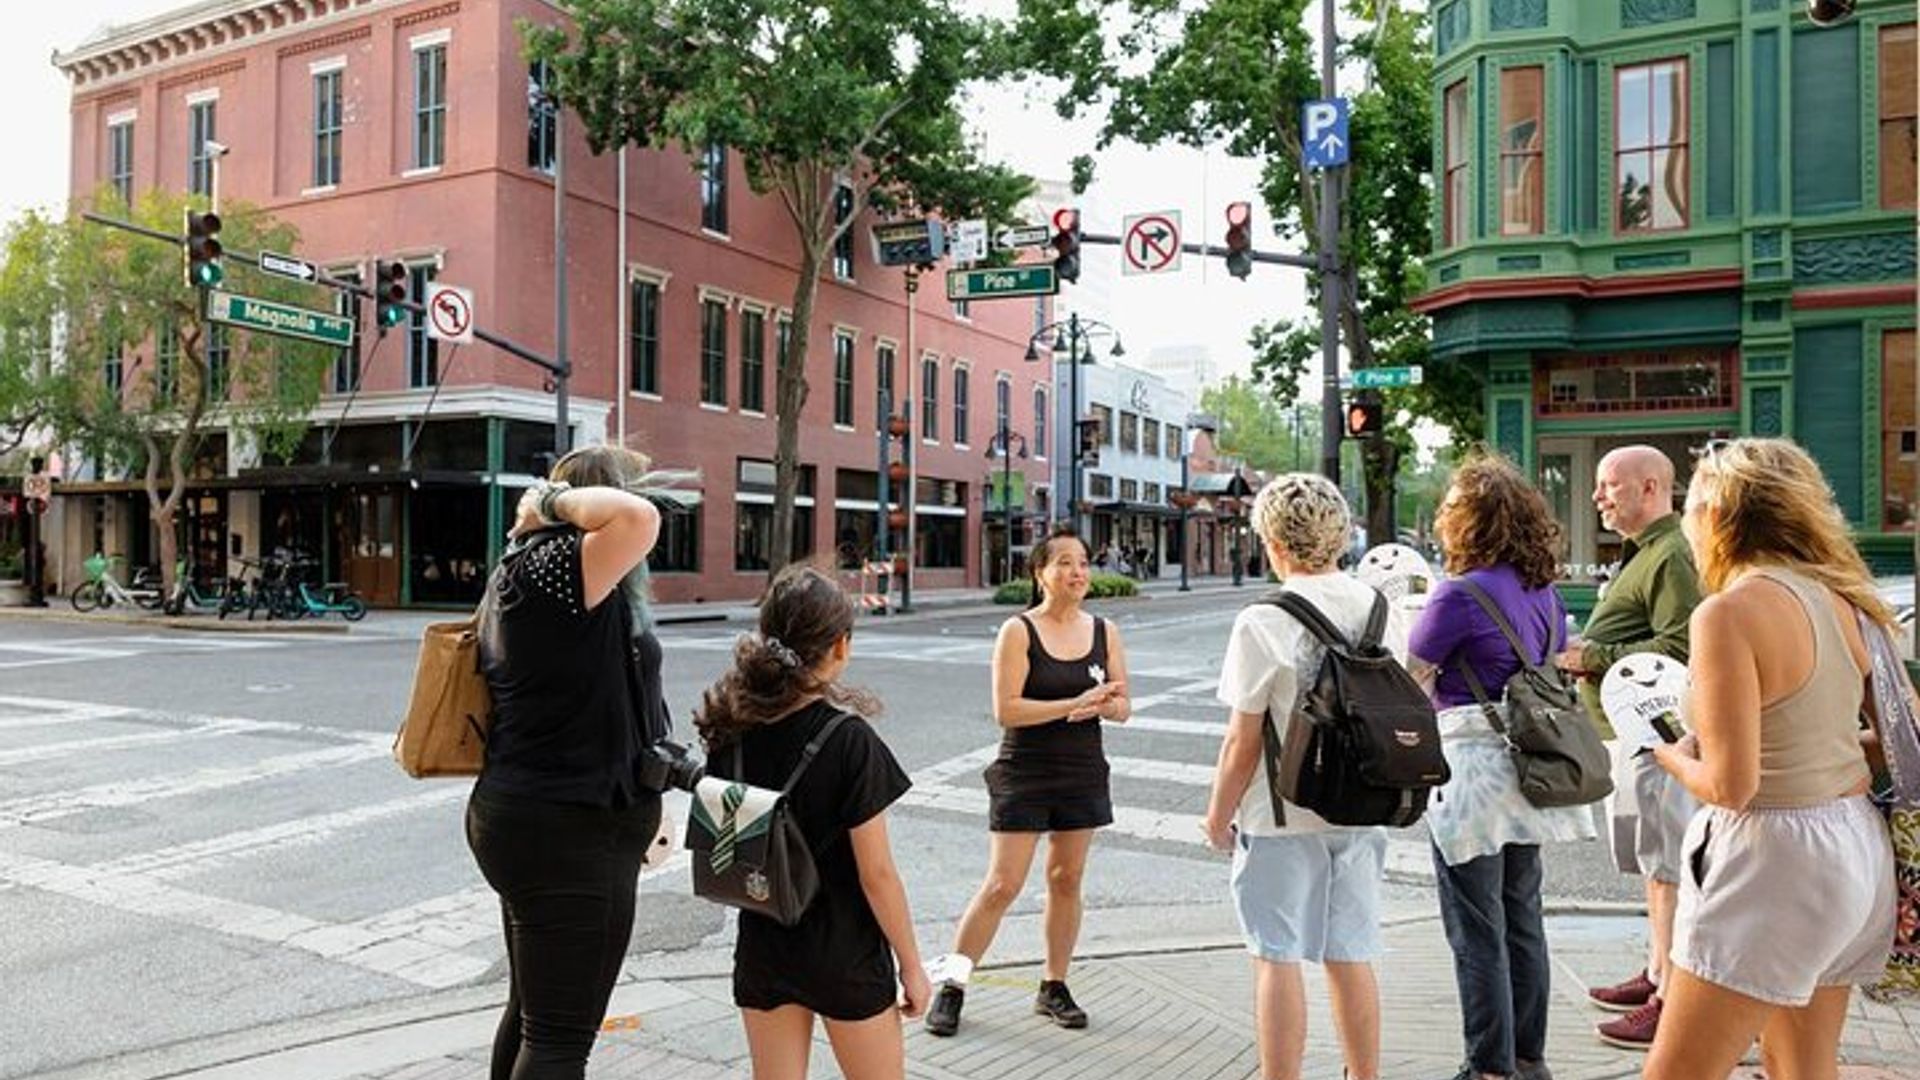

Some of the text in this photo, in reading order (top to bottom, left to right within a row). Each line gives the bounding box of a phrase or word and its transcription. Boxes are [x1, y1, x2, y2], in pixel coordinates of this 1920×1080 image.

[1307, 104, 1337, 141] P
[984, 271, 1016, 289] Pine
[244, 301, 317, 332] Magnolia
[1365, 371, 1394, 386] Pine
